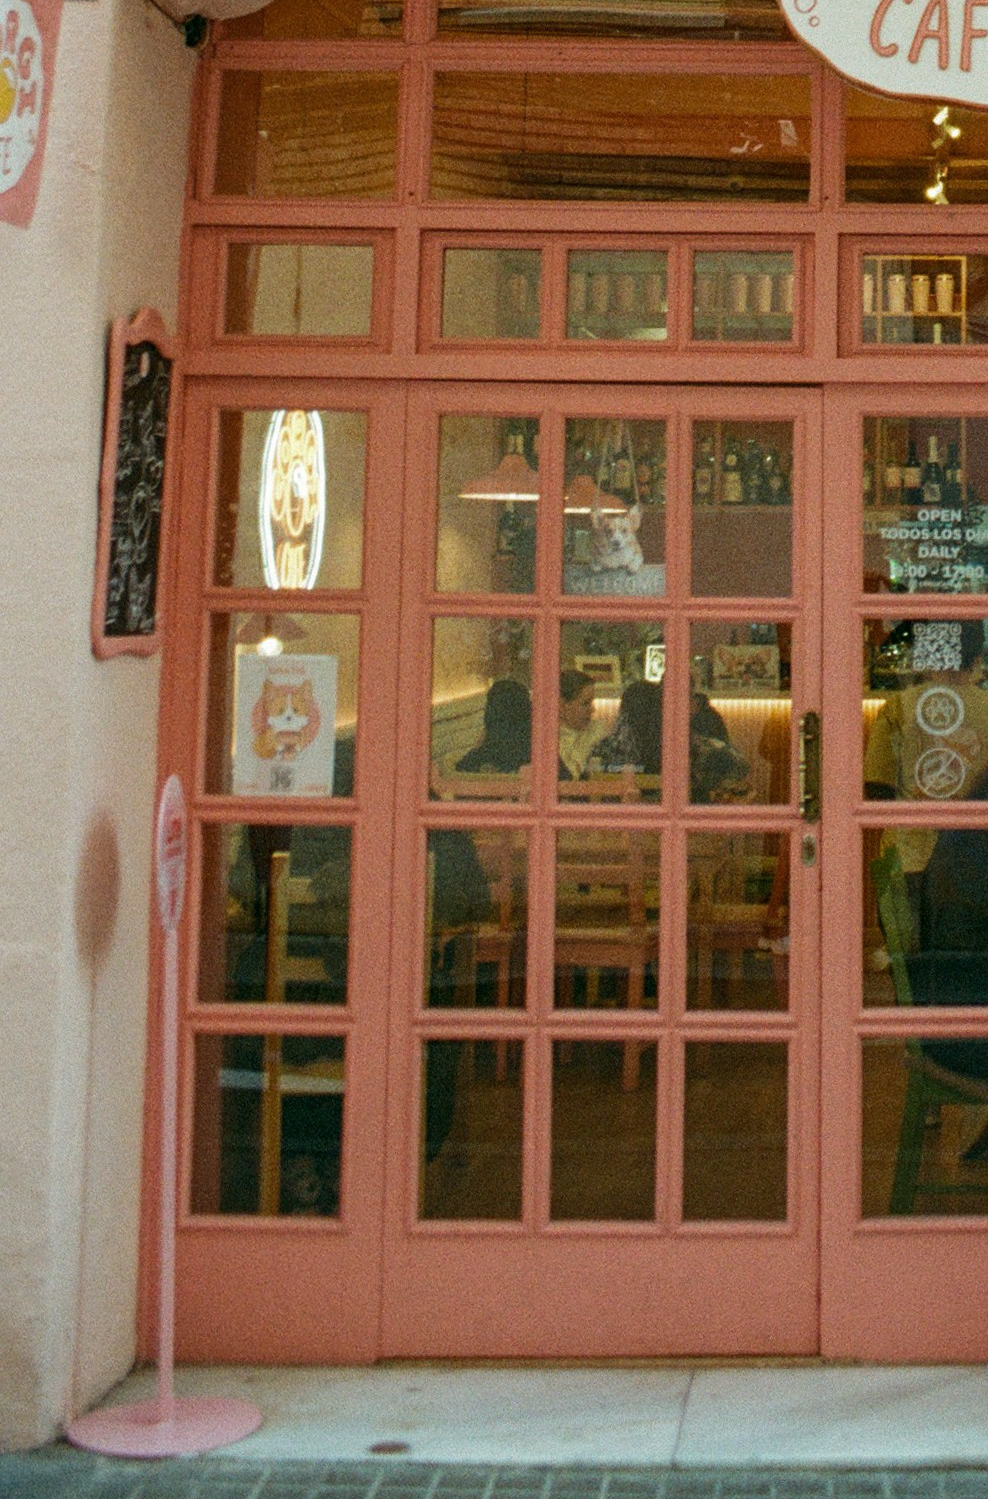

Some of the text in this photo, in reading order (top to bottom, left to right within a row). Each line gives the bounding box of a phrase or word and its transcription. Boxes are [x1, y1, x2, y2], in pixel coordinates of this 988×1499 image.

[917, 509, 962, 522] OPEN
[880, 527, 930, 540] TODOS
[933, 528, 962, 540] LOS
[917, 545, 961, 558] DAILY
